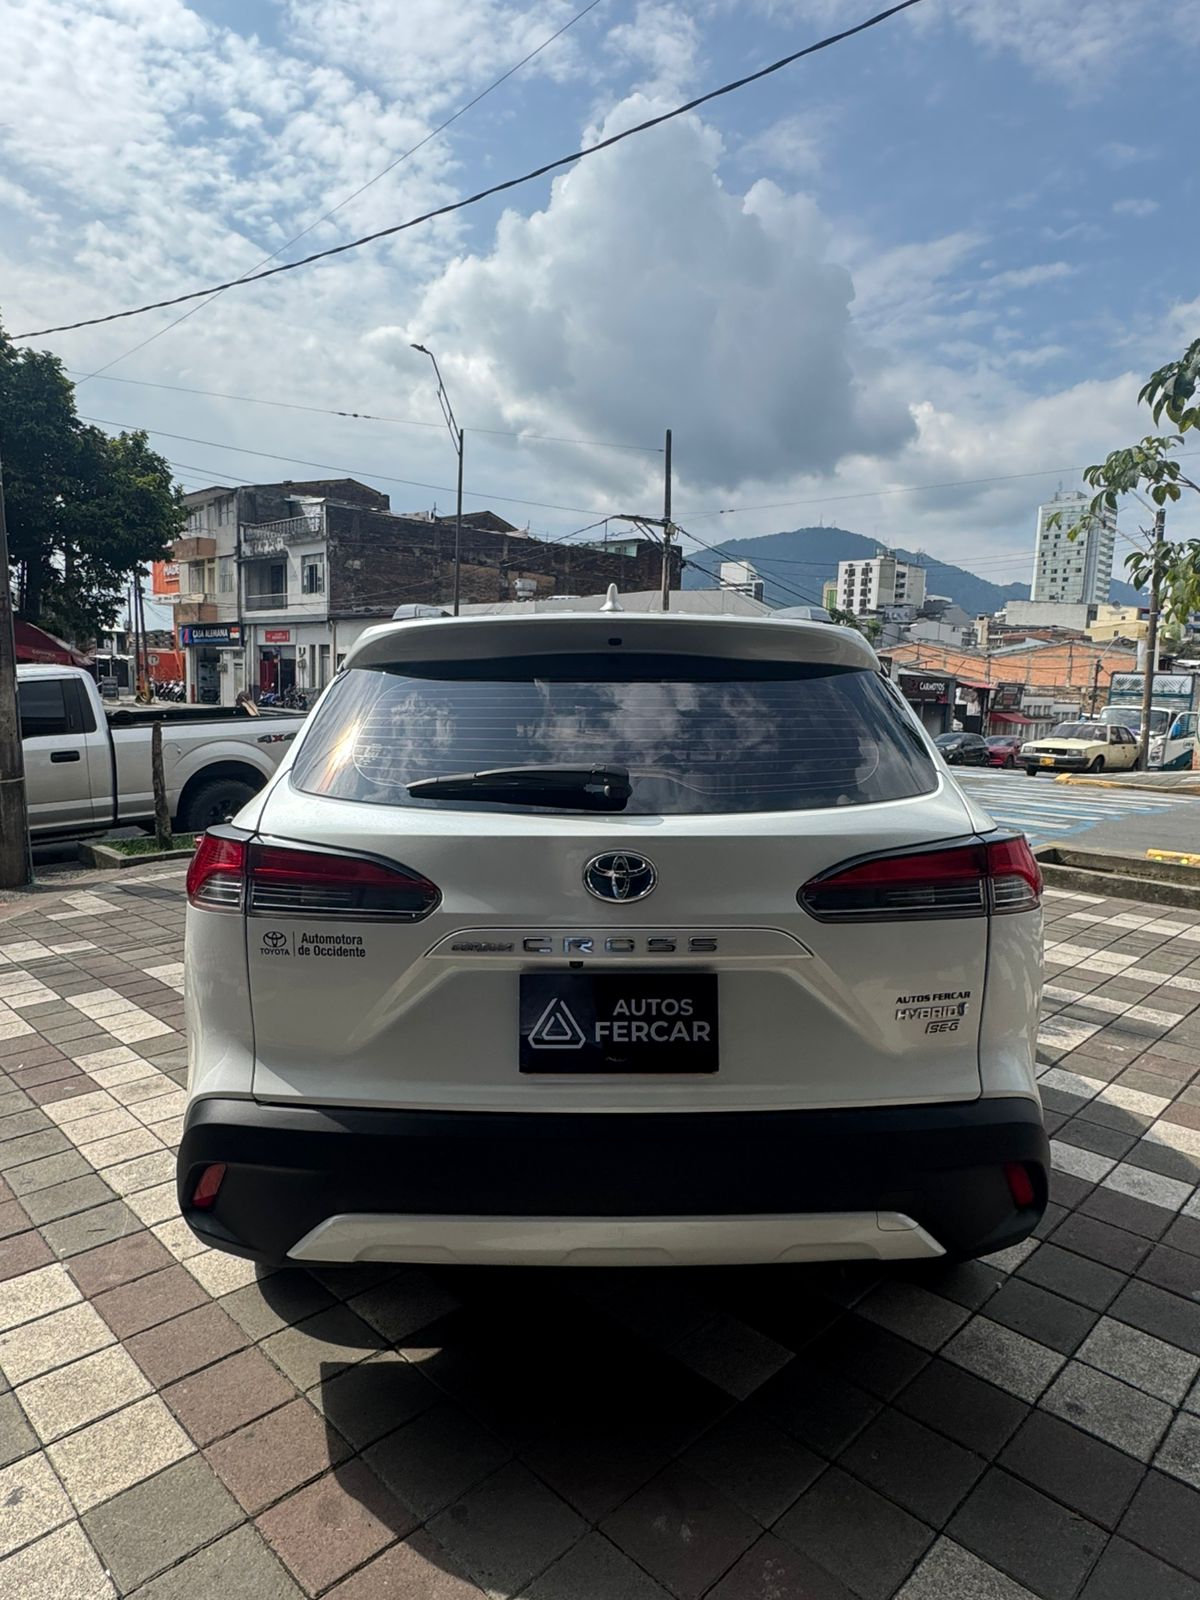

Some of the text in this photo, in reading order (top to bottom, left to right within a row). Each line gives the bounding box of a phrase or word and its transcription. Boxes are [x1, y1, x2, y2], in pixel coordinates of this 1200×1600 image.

[301, 932, 364, 945] Automotora
[522, 936, 719, 953] CROSS
[260, 948, 290, 956] TOYOTA
[298, 945, 367, 958] de Occidente
[896, 991, 970, 1004] AUTOS FERCAR
[613, 999, 693, 1016] AUTOS
[895, 1005, 960, 1020] HYBRID
[595, 1021, 711, 1043] FERCAR
